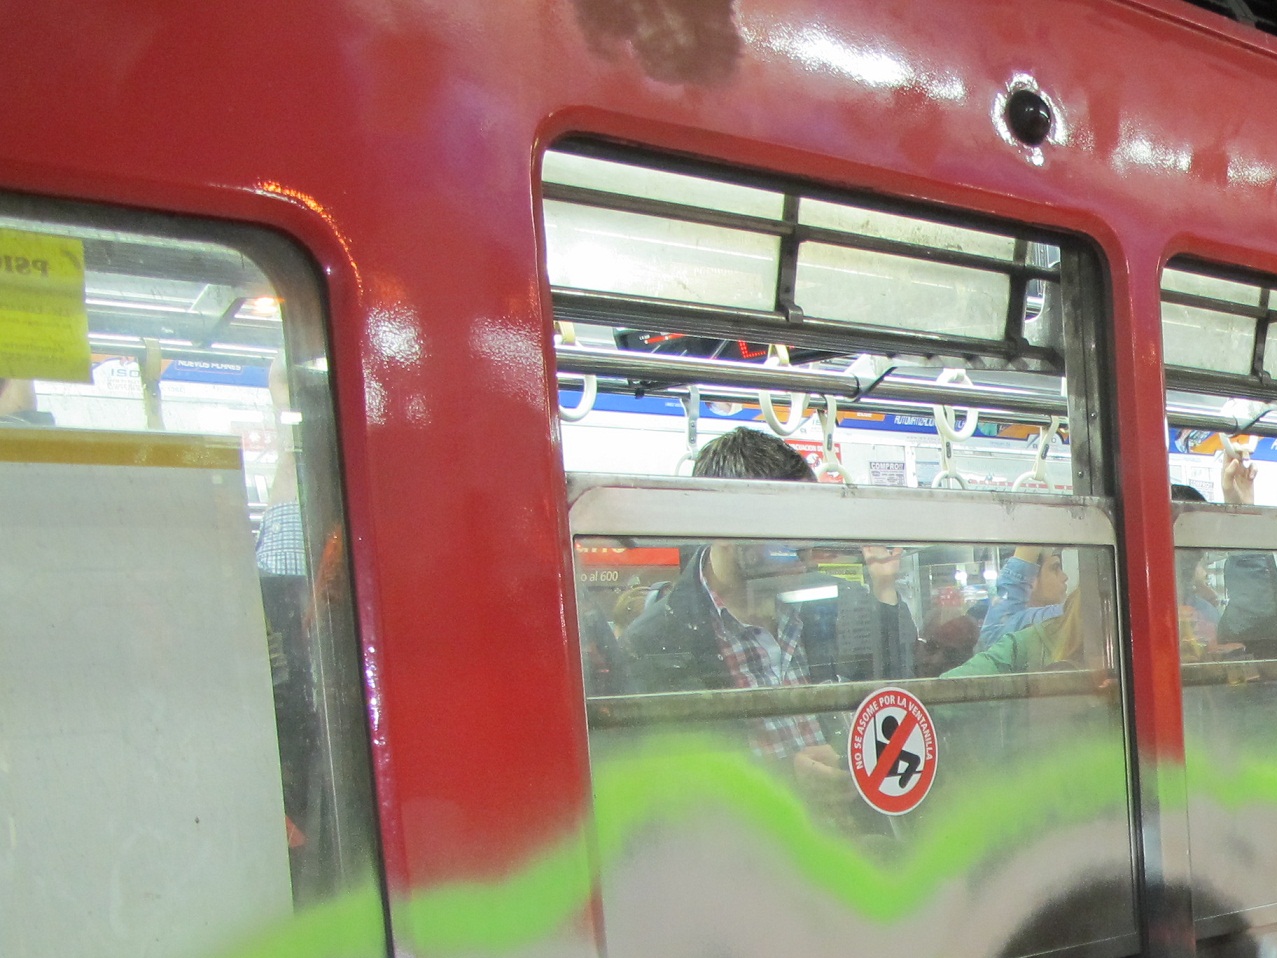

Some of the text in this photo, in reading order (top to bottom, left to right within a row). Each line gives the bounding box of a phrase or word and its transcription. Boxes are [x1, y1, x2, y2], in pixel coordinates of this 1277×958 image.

[600, 571, 618, 581] 600
[854, 695, 933, 769] NO SE ASOME POR LA VENTANILLA
